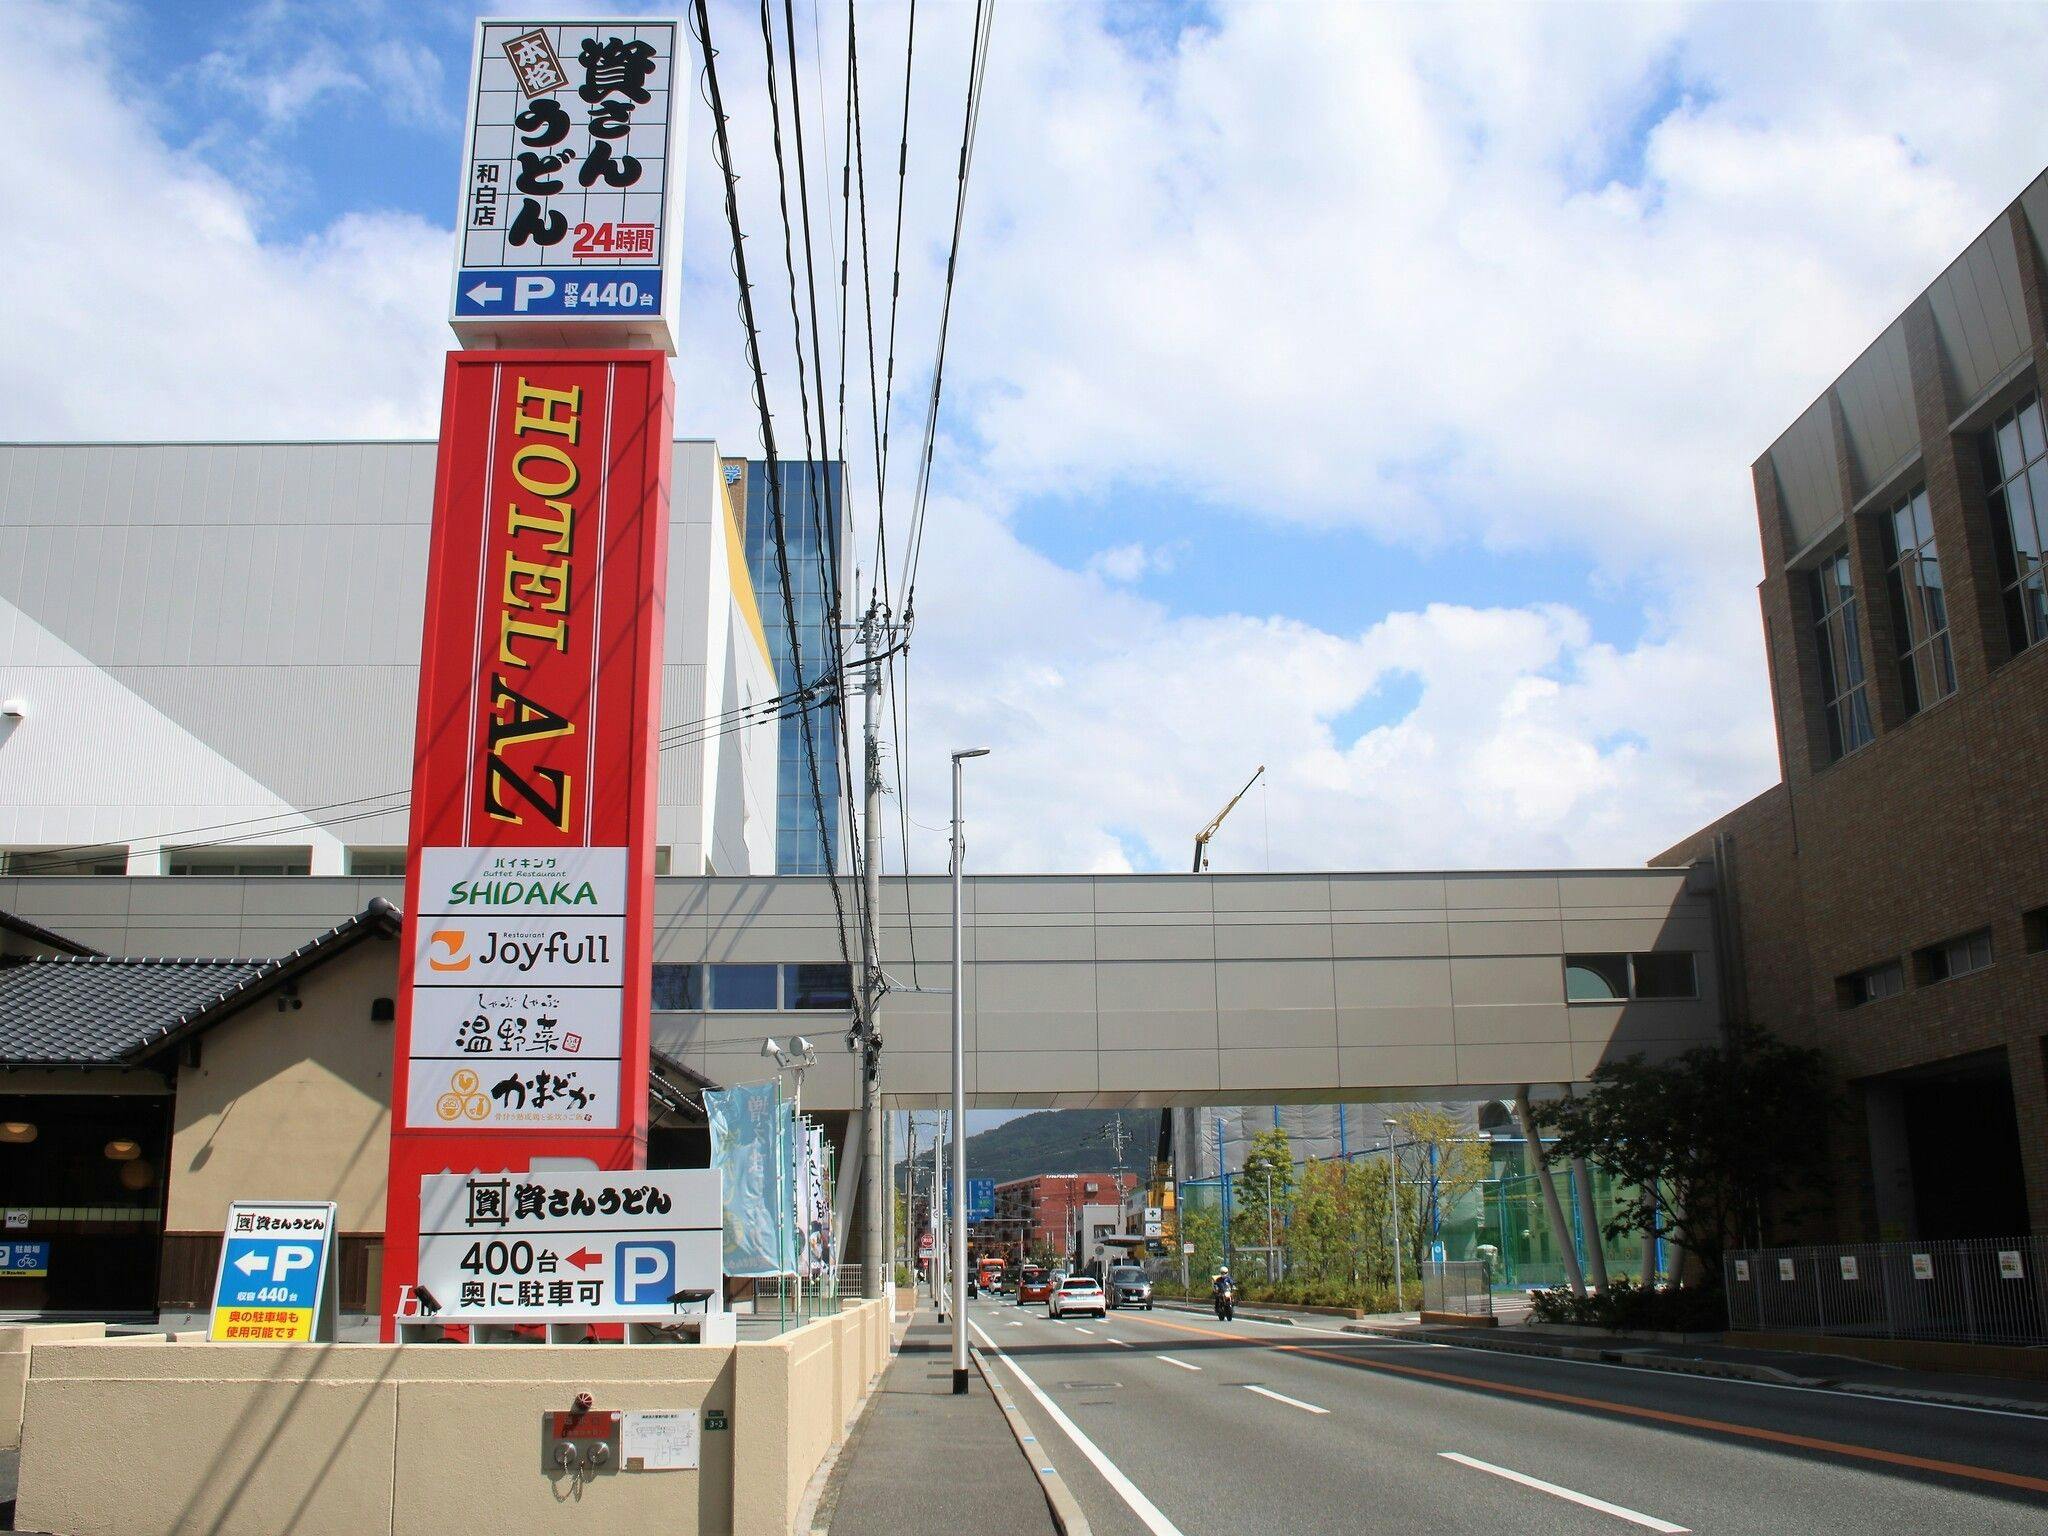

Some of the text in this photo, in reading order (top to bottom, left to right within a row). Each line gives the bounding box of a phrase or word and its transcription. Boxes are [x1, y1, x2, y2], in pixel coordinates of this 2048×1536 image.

[514, 40, 557, 90] 本格
[578, 36, 657, 189] 資さん
[508, 98, 576, 247] うどん
[472, 164, 499, 227] 和白店
[572, 222, 654, 253] 24時間
[513, 276, 556, 312] P
[484, 376, 583, 834] HOTEL AZ
[483, 870, 567, 878] Buffet Restaurant
[494, 858, 557, 869] バイキング
[448, 881, 598, 905] SHIDAKA
[479, 931, 610, 972] Joyfull
[455, 1014, 560, 1053] 温野菜
[491, 1070, 596, 1110] かまどか
[514, 1183, 672, 1220] 資さんうどん
[256, 1215, 324, 1231] 資さんうどん
[272, 1245, 315, 1282] P
[460, 1240, 559, 1276] 400台
[624, 1247, 669, 1302] P
[460, 1279, 604, 1307] 奥に駐車可
[227, 1326, 298, 1338] 使用可能です
[229, 1311, 299, 1323] 奥の駐車場も
